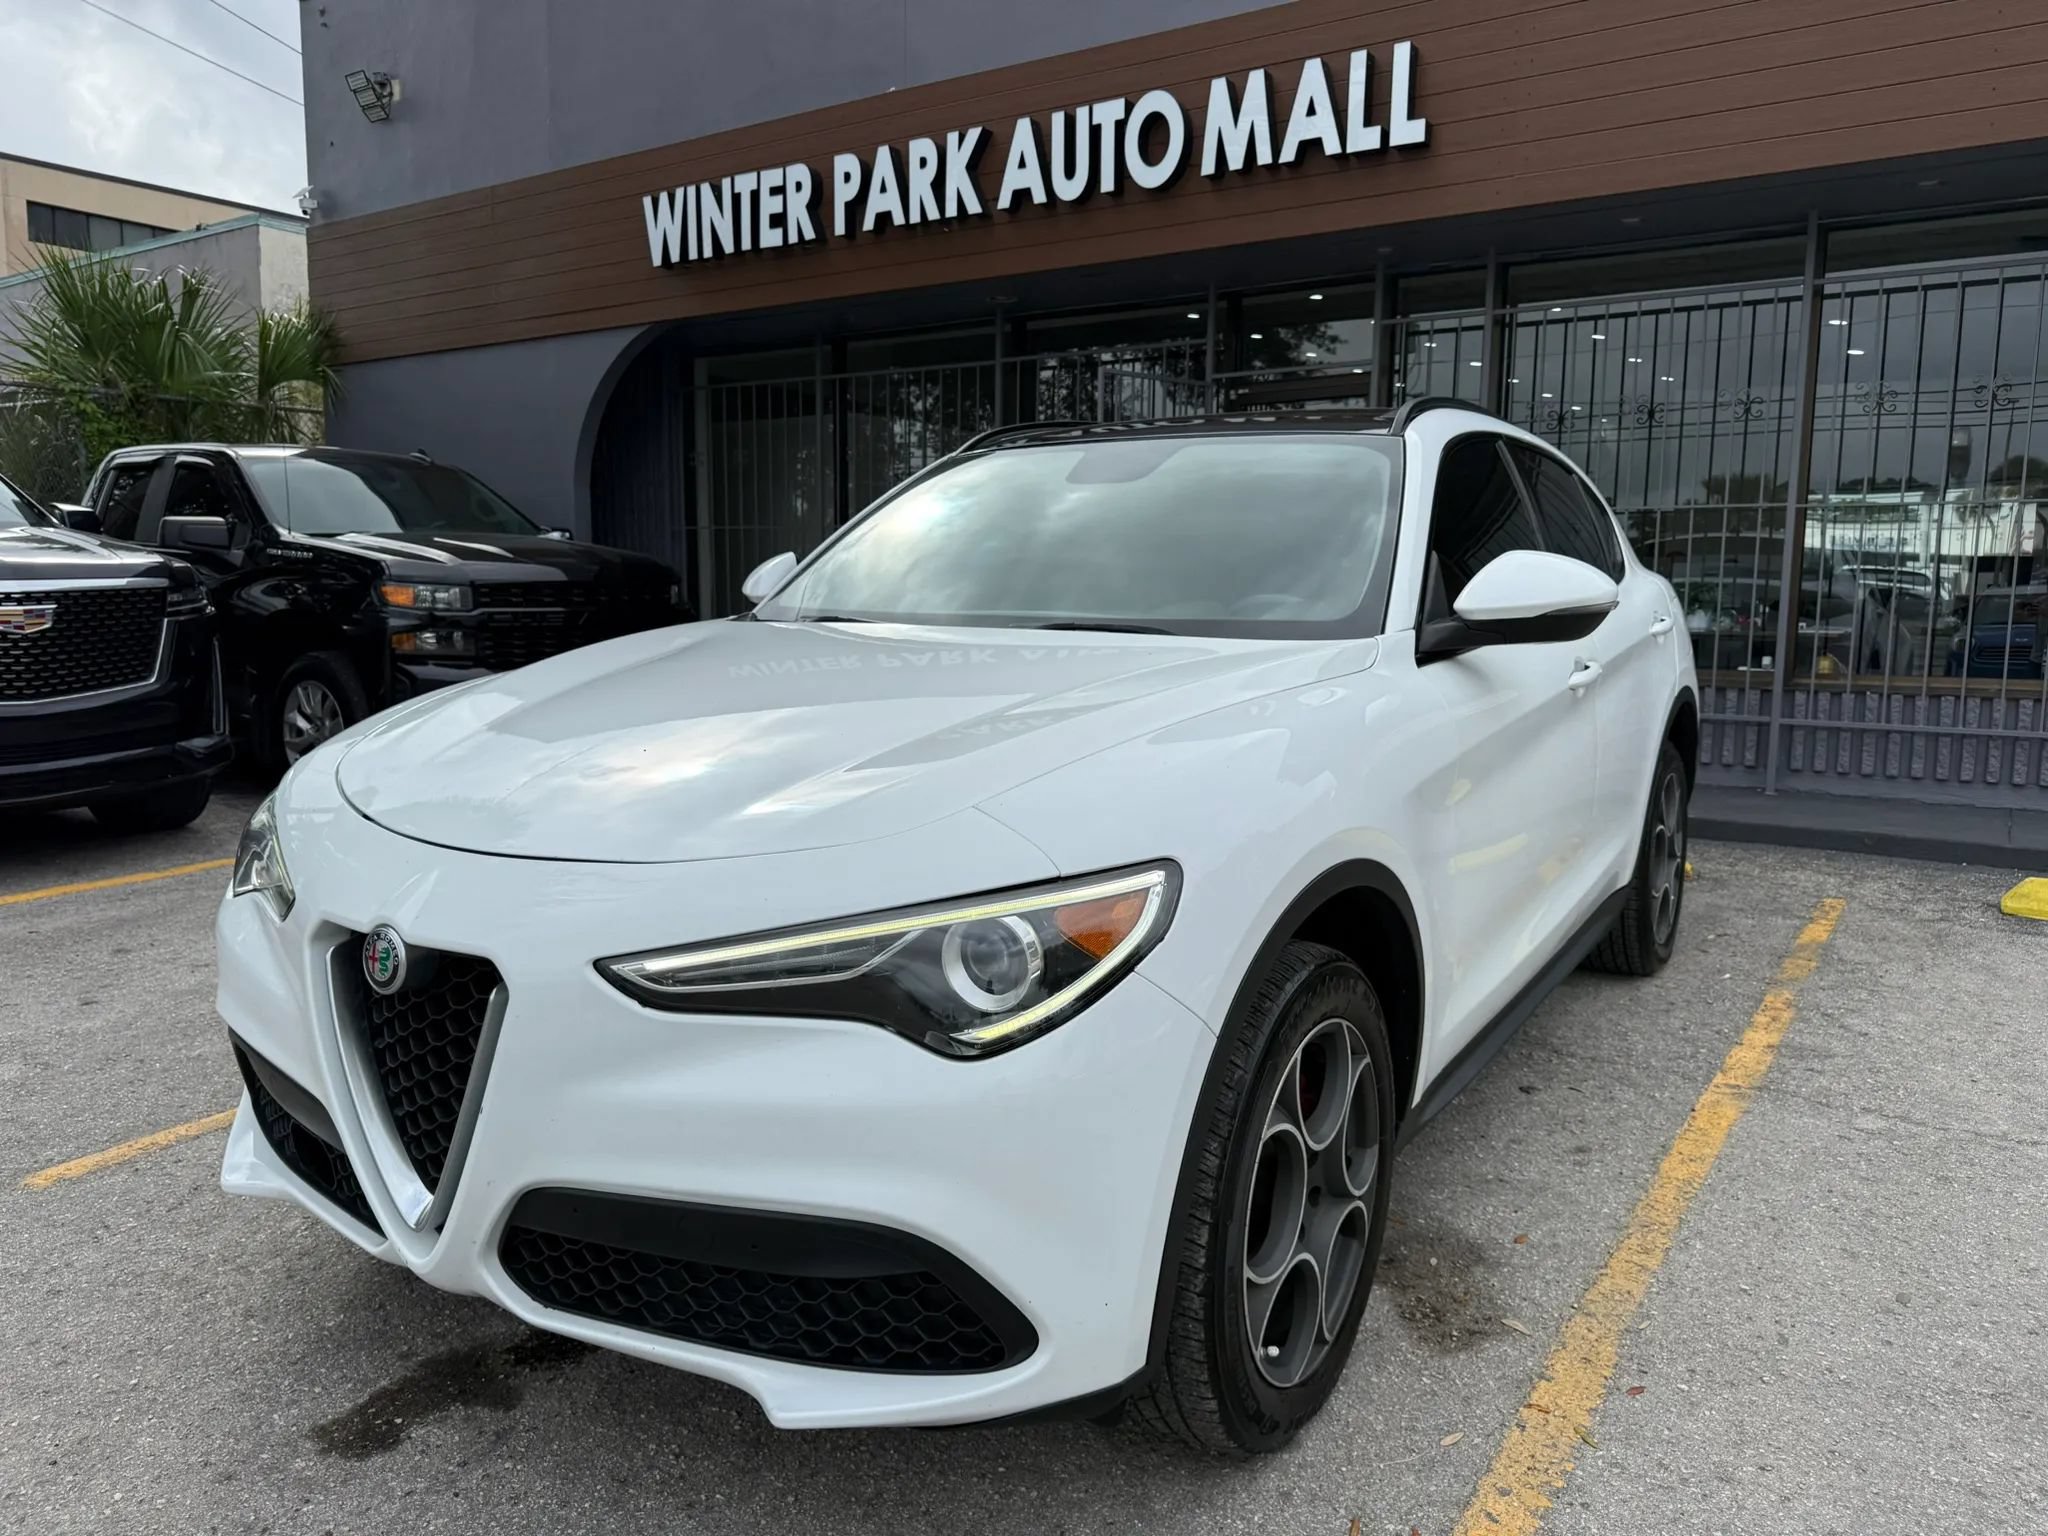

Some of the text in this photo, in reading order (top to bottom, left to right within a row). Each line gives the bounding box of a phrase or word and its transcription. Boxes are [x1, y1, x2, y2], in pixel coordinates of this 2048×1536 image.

[642, 41, 1427, 268] WINTER PARK AUTO MALL
